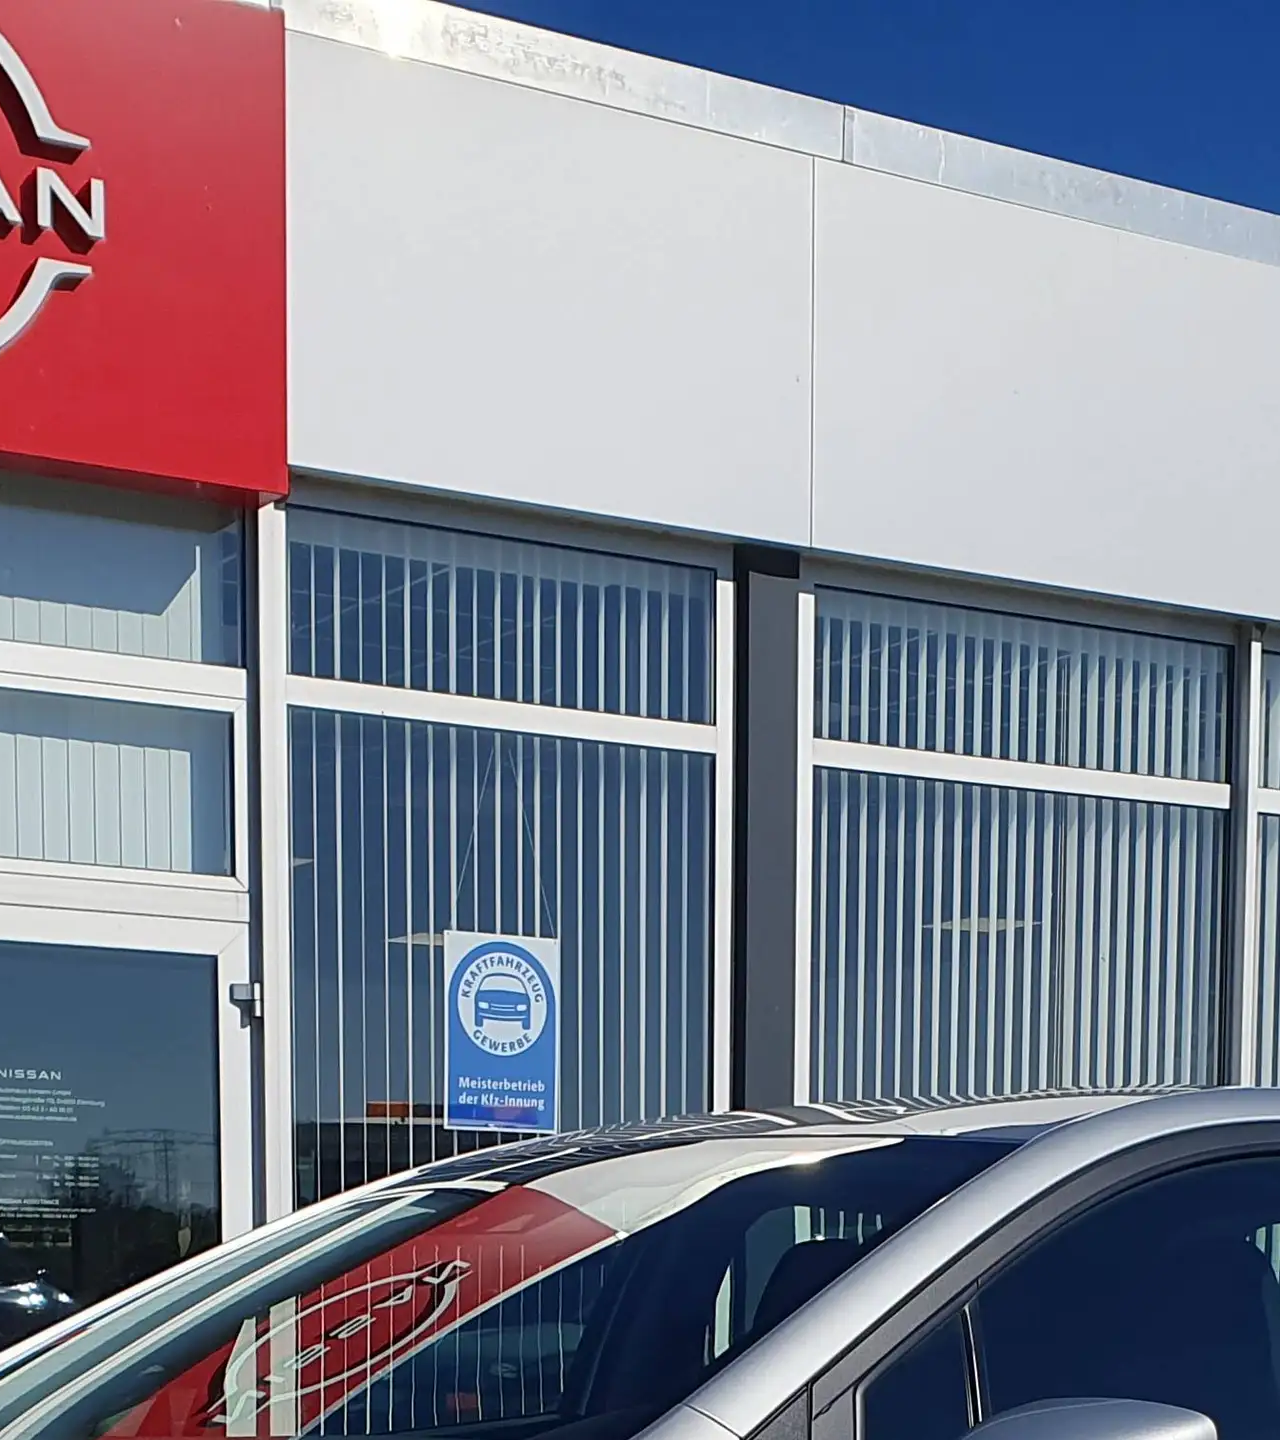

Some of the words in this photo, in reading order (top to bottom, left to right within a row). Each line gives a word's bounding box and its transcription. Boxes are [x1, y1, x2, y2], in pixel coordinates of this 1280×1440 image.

[461, 956, 544, 1004] KRAFTFAHRZEUG
[472, 1028, 532, 1053] GEWERBE
[458, 1076, 545, 1092] Meisterbetrieb
[458, 1094, 478, 1105] der
[480, 1094, 545, 1110] Kfz-Innung
